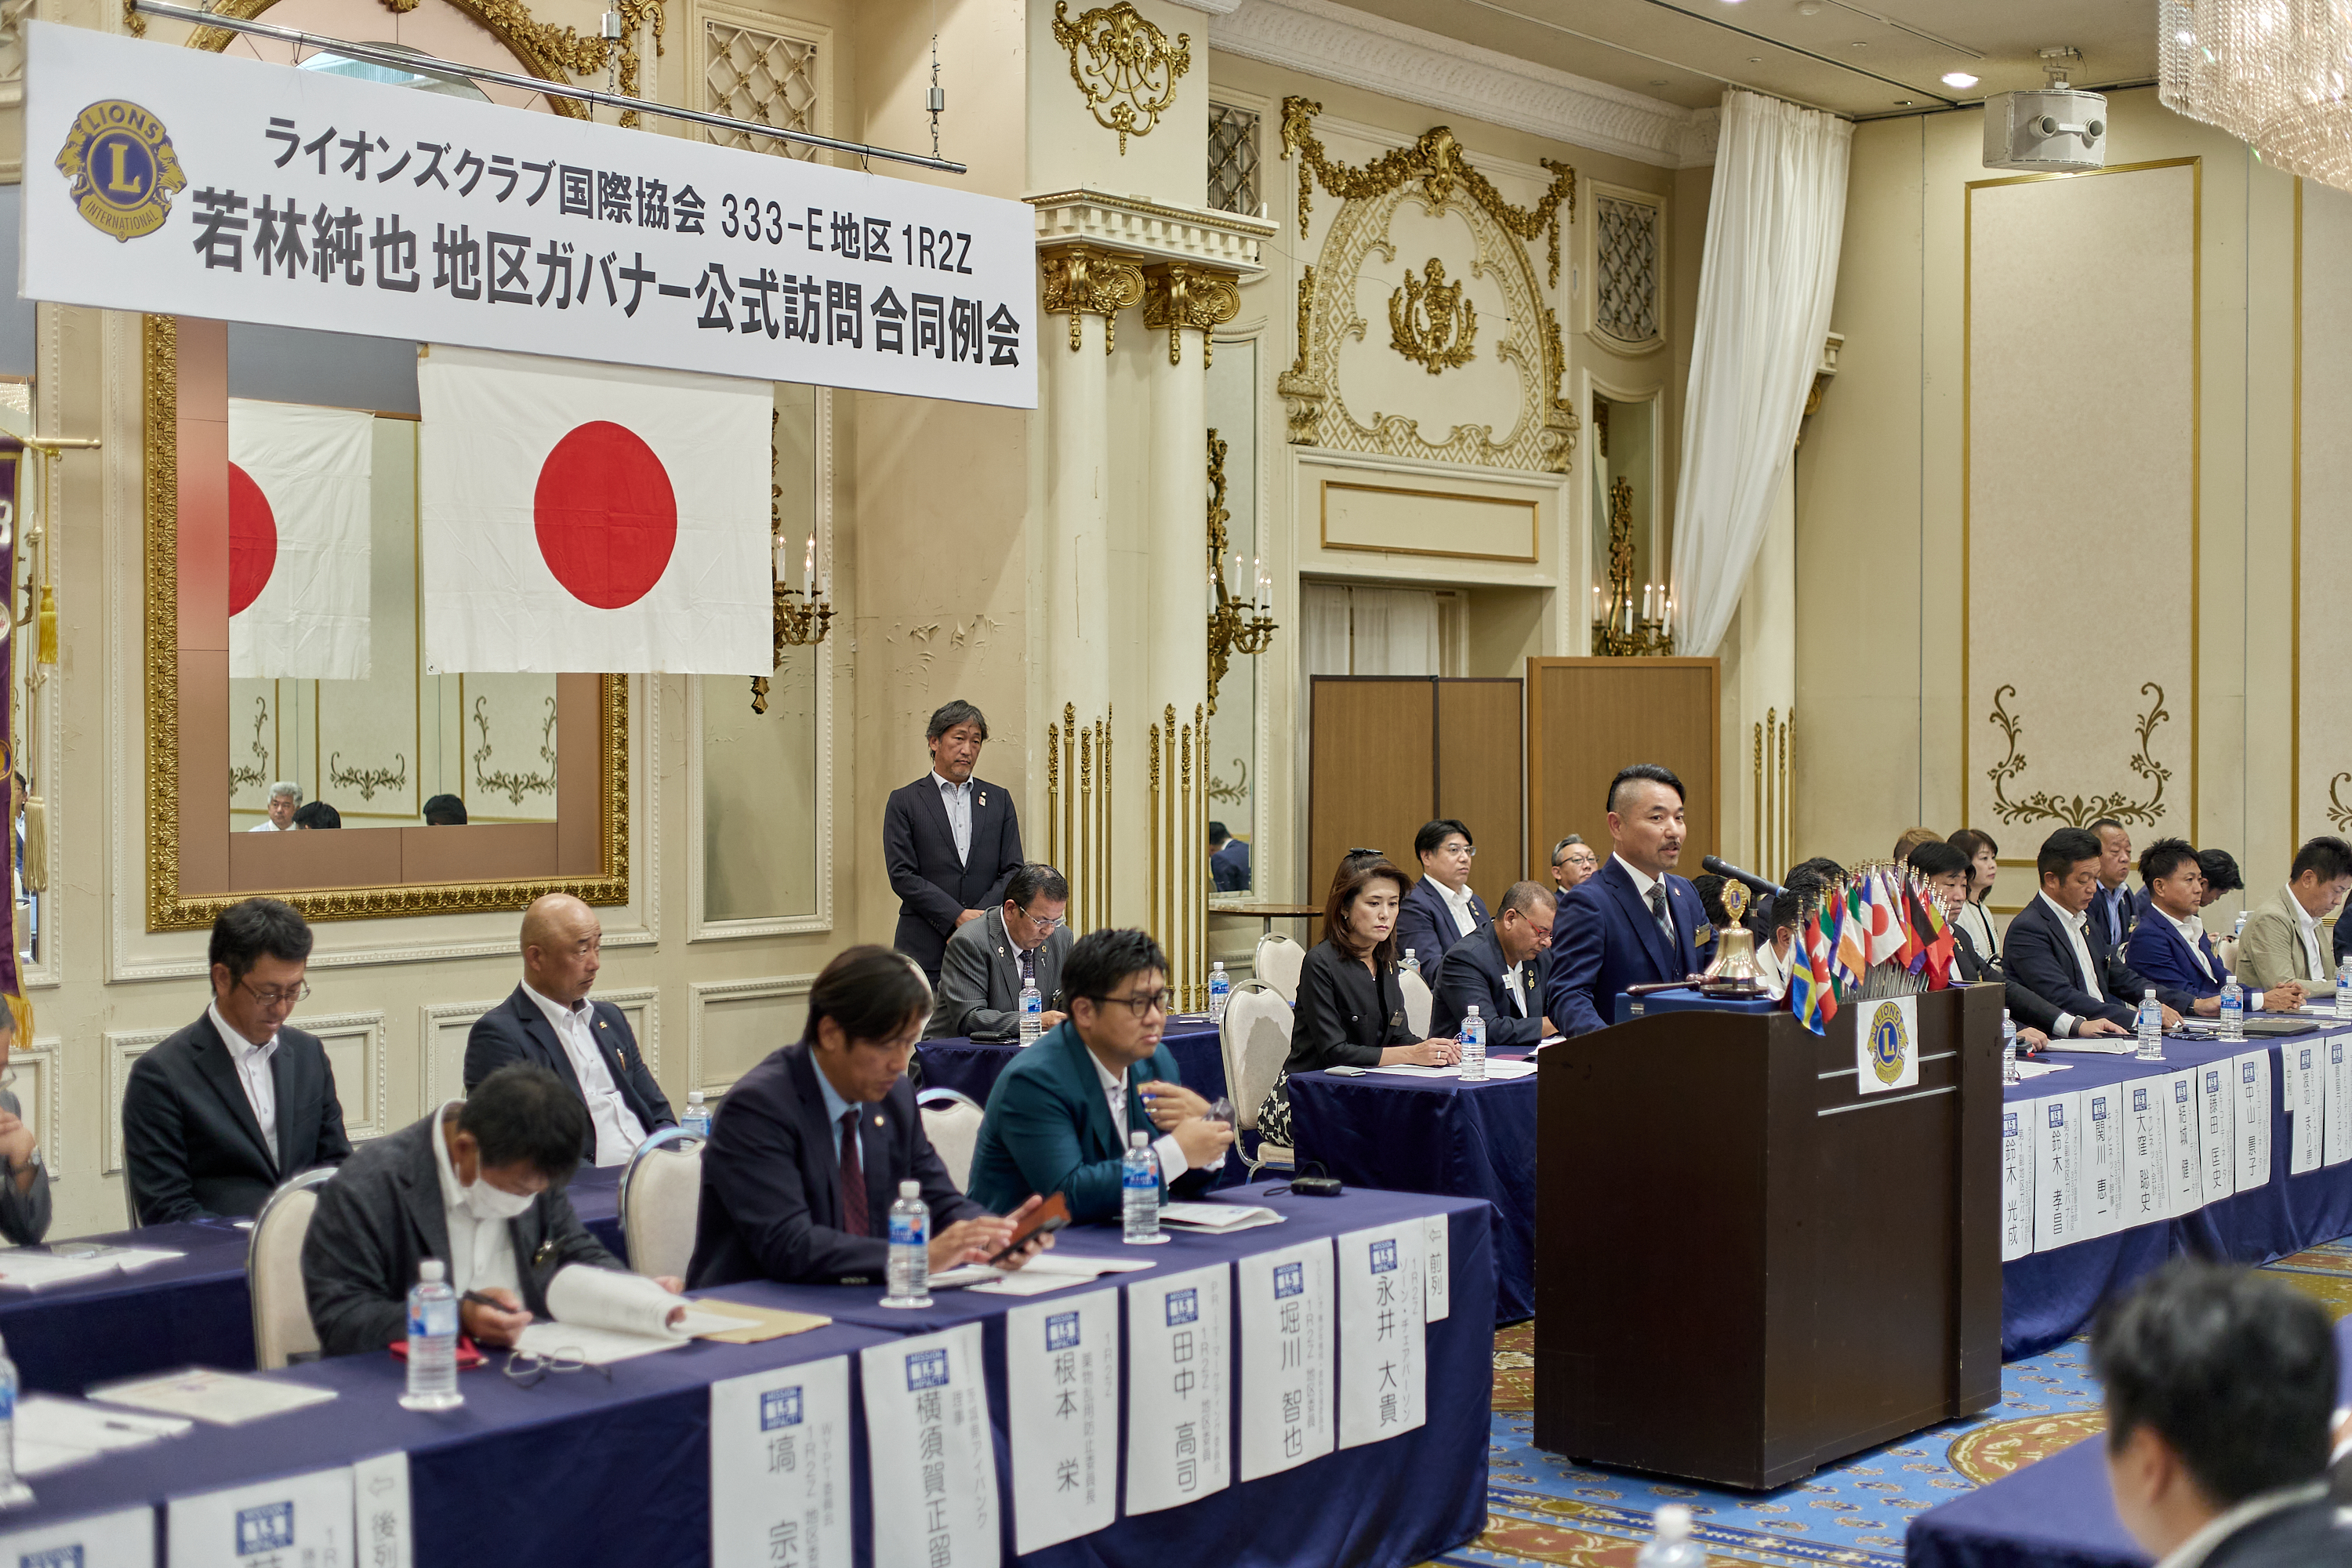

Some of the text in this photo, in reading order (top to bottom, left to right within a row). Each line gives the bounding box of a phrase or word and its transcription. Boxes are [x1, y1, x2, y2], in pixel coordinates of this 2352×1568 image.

[85, 104, 159, 140] LIONS
[108, 143, 142, 193] L
[85, 200, 158, 230] INTERNATIONAL
[265, 116, 706, 235] ライオンズクラブ国際協会
[903, 227, 972, 274] 1R2Z
[192, 186, 420, 292] 若林純也
[1876, 1004, 1900, 1022] LIONS
[1883, 1027, 1896, 1057] L
[2245, 1083, 2256, 1123] 中山
[2136, 1113, 2147, 1156] 大窪
[2052, 1130, 2063, 1235] 鈴木 孝昌
[2096, 1120, 2107, 1214] 関川 恵一
[2005, 1138, 2018, 1247] 鈴木 光成
[1283, 1272, 1294, 1287] 1.5
[1379, 1248, 1389, 1264] 1.5
[1429, 1253, 1443, 1297] 前列
[1178, 1298, 1189, 1314] 1.5
[1058, 1323, 1069, 1340] 1.5
[1377, 1276, 1397, 1427] 永井 大貴
[920, 1360, 935, 1377] 1.5
[1104, 1332, 1113, 1398] 1R2Z
[1201, 1327, 1210, 1389] 1R2Z
[1280, 1301, 1303, 1459] 堀川 智也
[775, 1398, 793, 1416] 1.5
[1054, 1351, 1080, 1493] 根本 栄
[1173, 1331, 1197, 1493] 田中 高司
[805, 1425, 816, 1497] 1R2Z
[768, 1432, 798, 1568] 塙 宗
